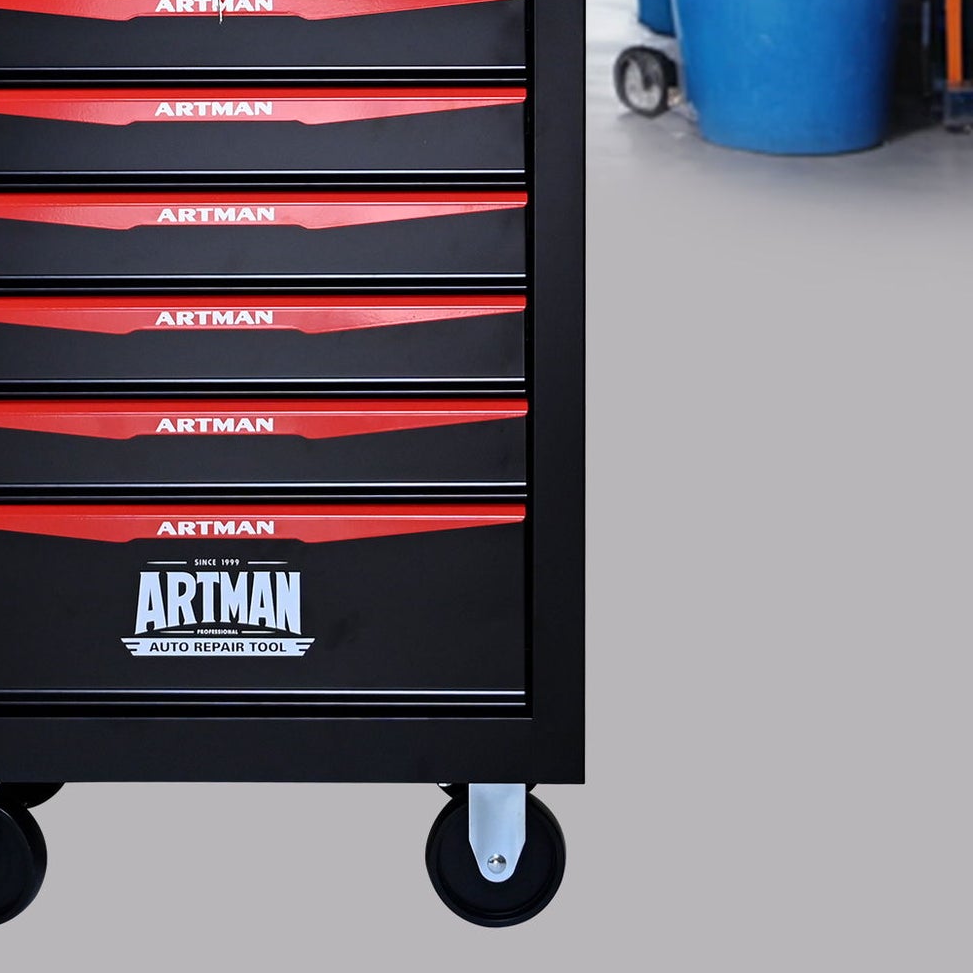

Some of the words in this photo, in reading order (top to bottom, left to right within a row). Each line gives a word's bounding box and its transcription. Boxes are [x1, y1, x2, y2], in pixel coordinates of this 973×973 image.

[154, 101, 273, 117] ARTMAN
[157, 206, 276, 223] ARTMAN
[155, 310, 274, 326] ARTMAN
[155, 417, 274, 433] ARTMAN
[156, 520, 275, 536] ARTMAN
[194, 558, 217, 567] SINCE
[221, 558, 240, 567] 1999
[134, 571, 302, 635] ARTMAN
[196, 628, 239, 636] PROFESSIONAL
[149, 641, 189, 652] AUTO
[194, 641, 245, 652] REPAIR
[249, 641, 287, 652] TOOL
